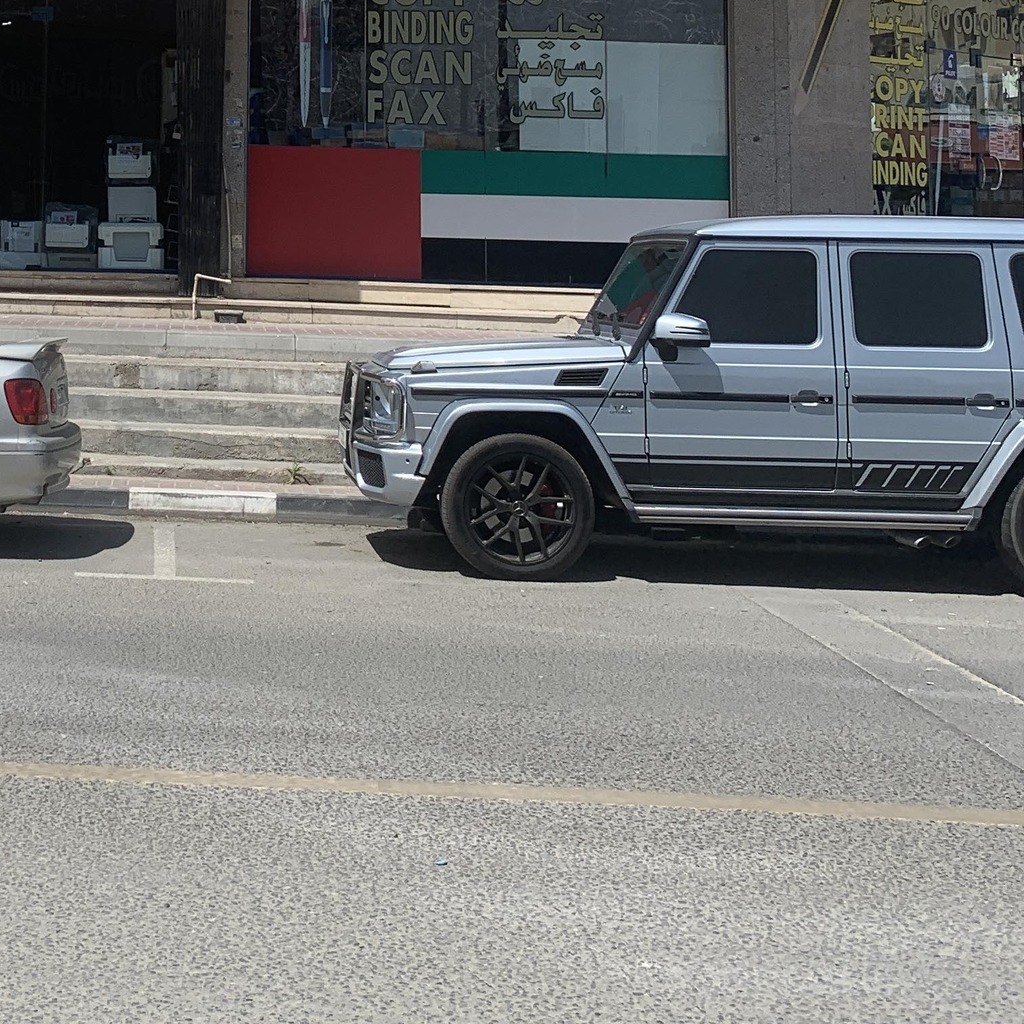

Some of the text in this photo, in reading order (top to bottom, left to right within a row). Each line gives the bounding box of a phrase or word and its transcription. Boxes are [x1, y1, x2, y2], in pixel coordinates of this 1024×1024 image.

[367, 10, 475, 45] BINDING
[496, 12, 605, 51] تجليد
[931, 4, 950, 31] 90
[954, 8, 1010, 41] COLOUR
[368, 49, 474, 86] SCAN
[496, 44, 604, 92] مسح ضوئي
[367, 89, 447, 126] FAX
[509, 87, 605, 125] فاكس
[873, 160, 928, 188] INDING
[873, 189, 892, 215] AX
